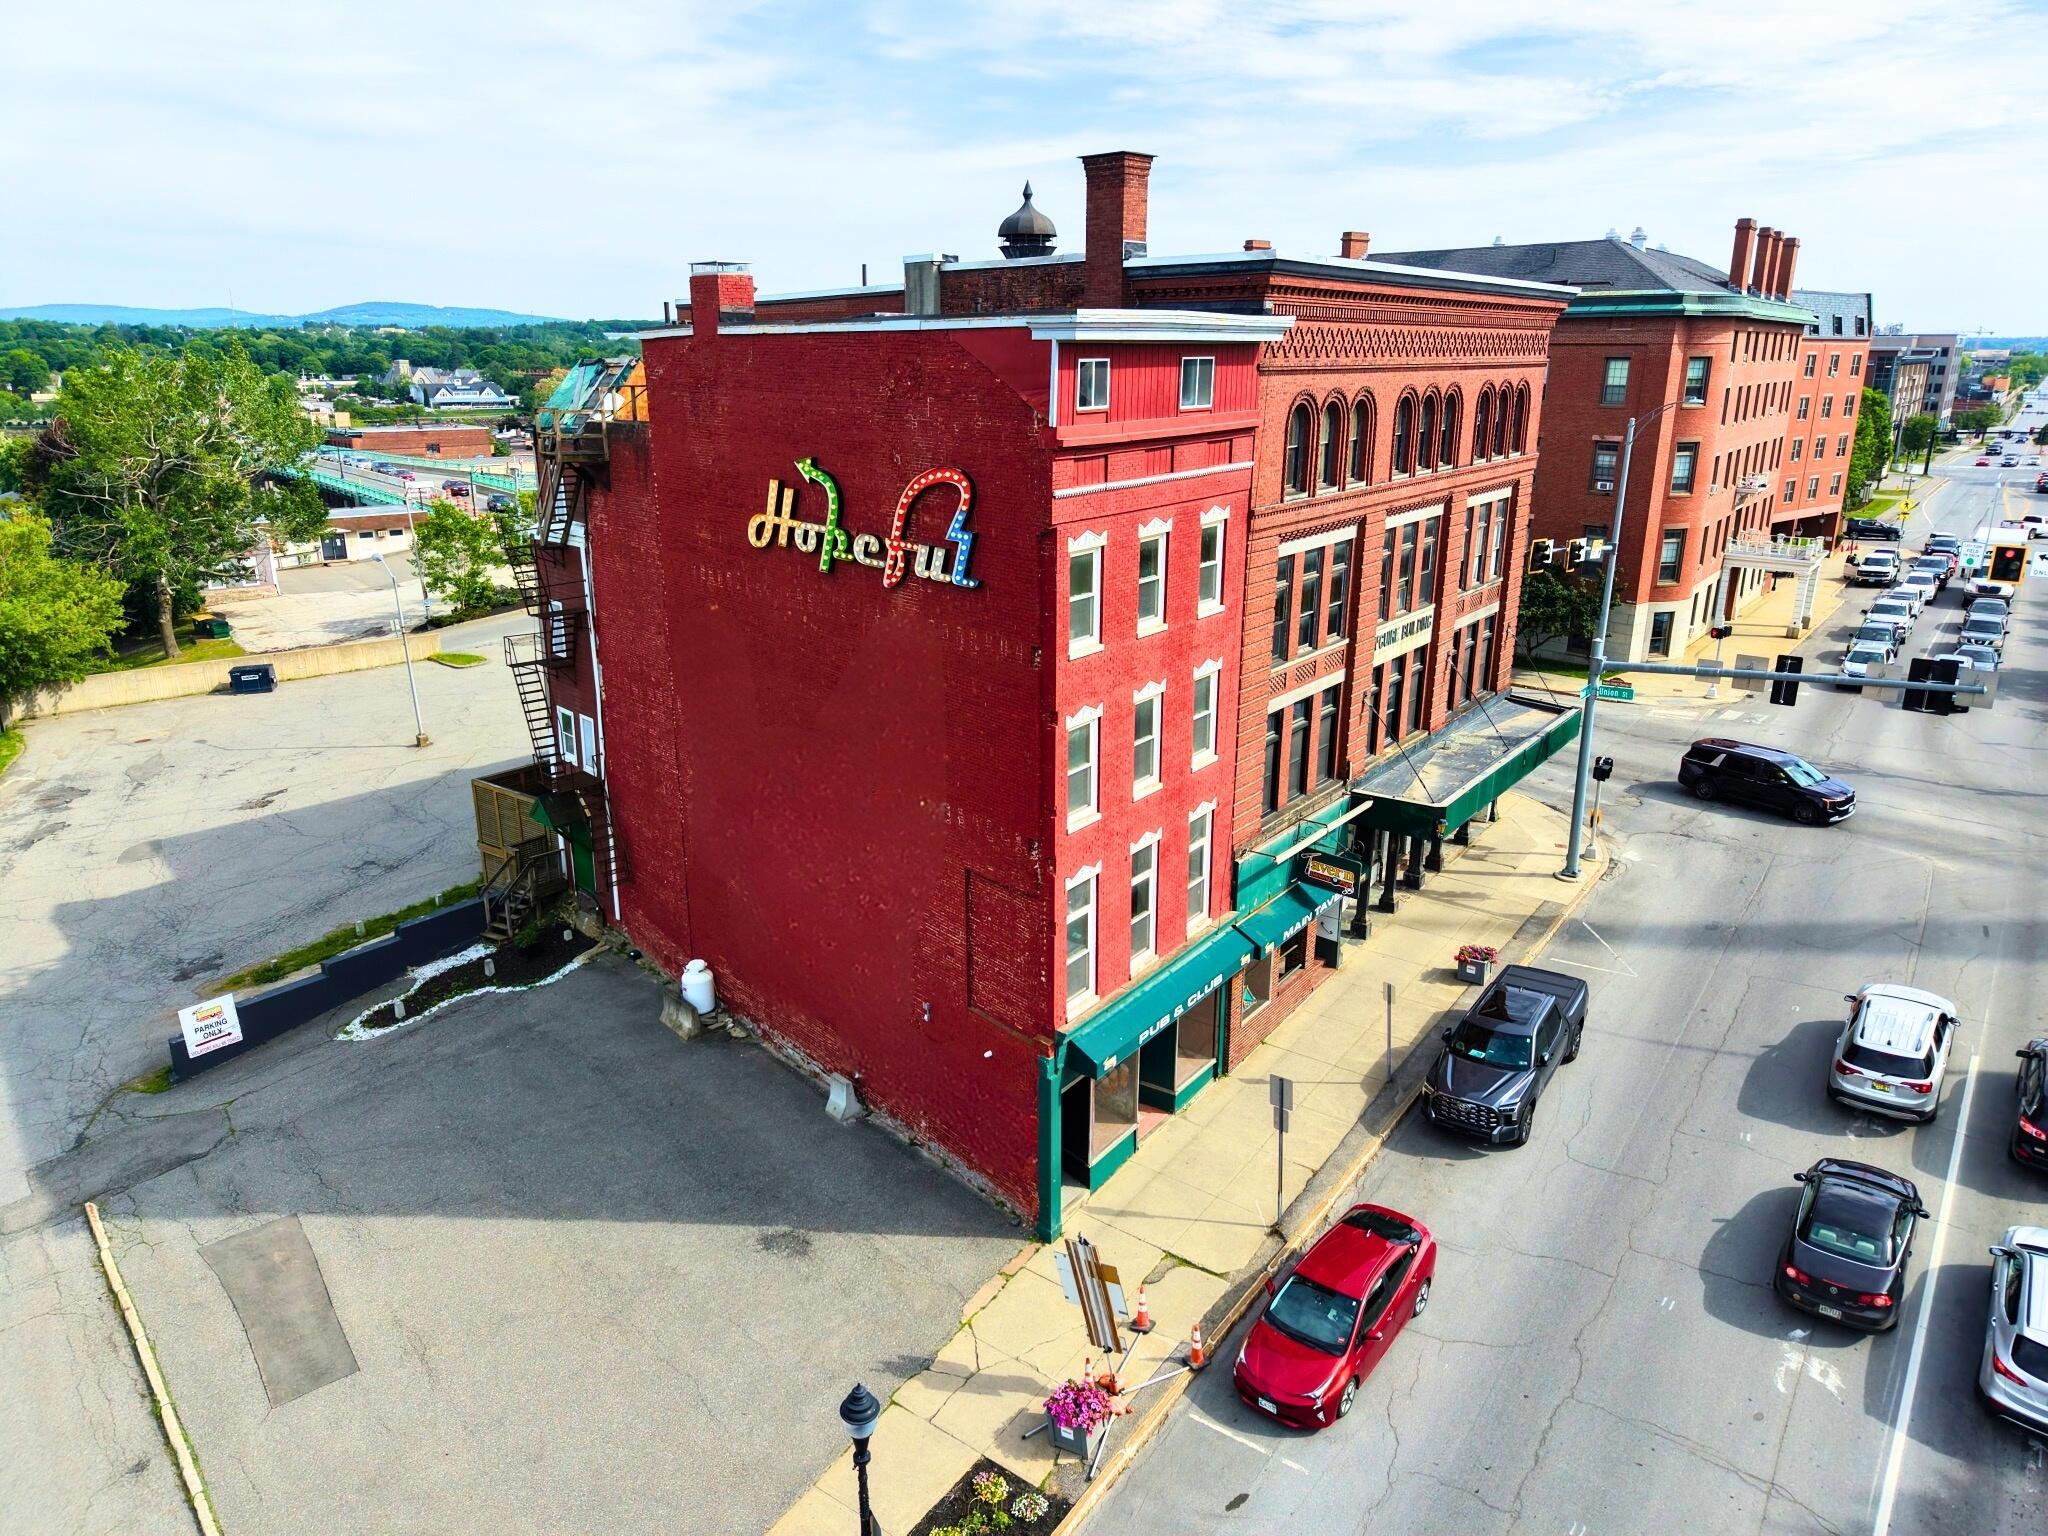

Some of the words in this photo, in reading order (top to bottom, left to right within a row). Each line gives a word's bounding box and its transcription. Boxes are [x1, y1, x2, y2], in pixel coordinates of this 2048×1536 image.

[748, 457, 980, 588] Hopeful
[1599, 687, 1619, 697] Union
[1283, 912, 1313, 940] MAIN
[1139, 1014, 1170, 1044] PUB
[1174, 1004, 1184, 1017] &
[1187, 974, 1223, 1007] CLUB
[194, 1018, 228, 1034] PARKING
[203, 1028, 223, 1039] ONLY
